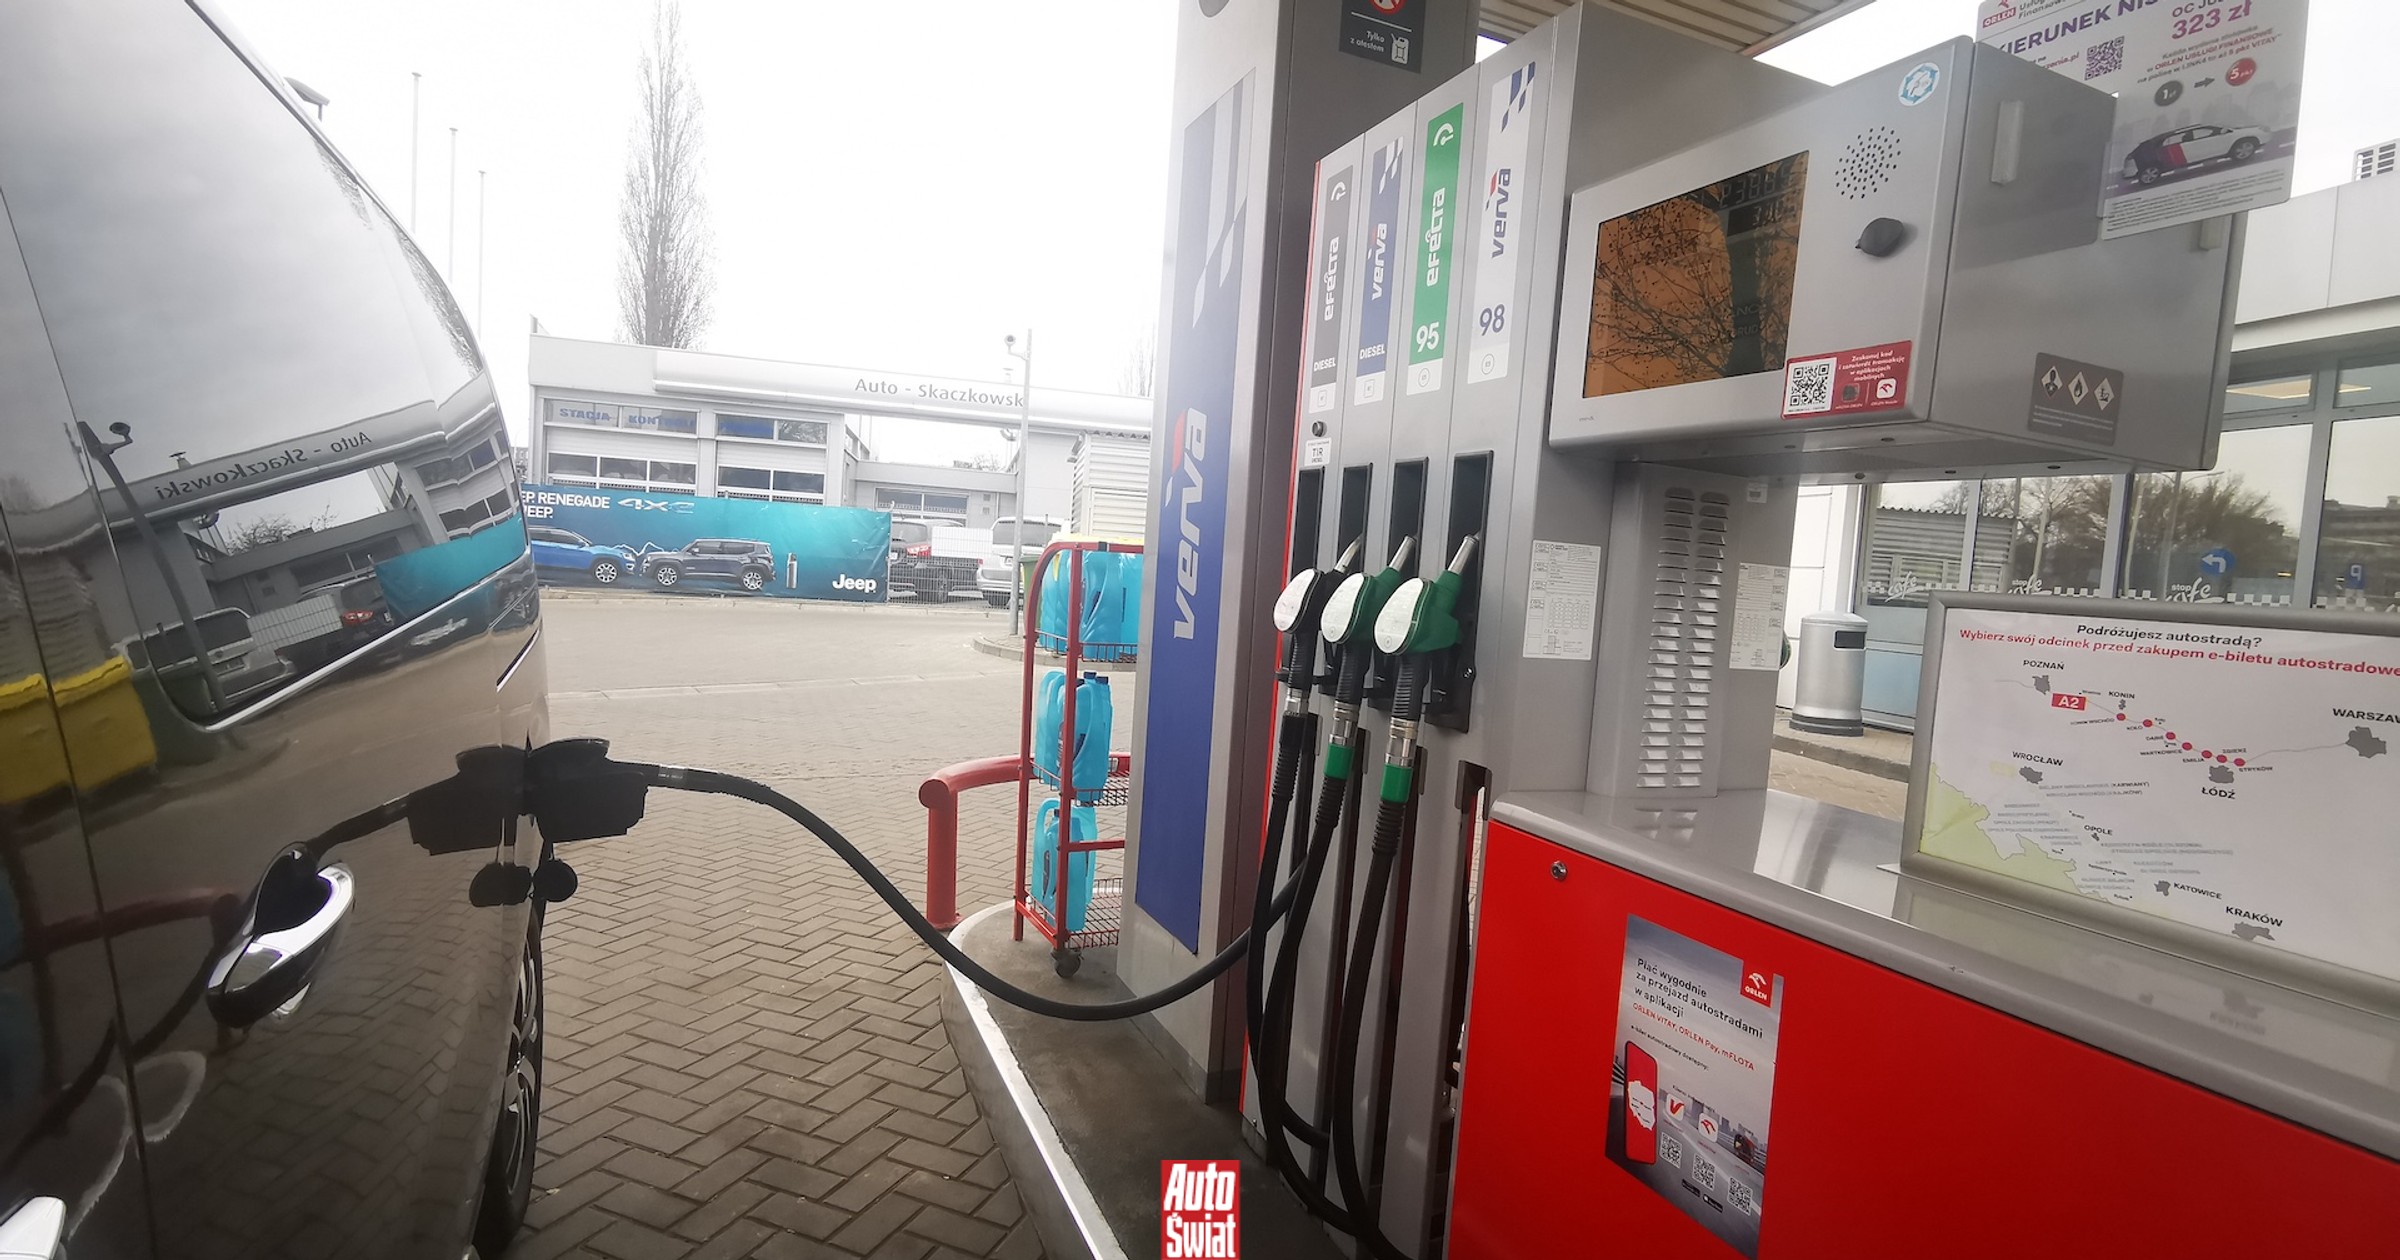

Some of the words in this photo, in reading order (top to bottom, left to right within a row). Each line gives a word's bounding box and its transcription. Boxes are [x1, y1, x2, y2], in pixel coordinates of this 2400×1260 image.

[1984, 8, 2016, 27] ORLEN
[2172, 3, 2195, 17] OC
[2172, 8, 2222, 39] 323
[1366, 30, 1385, 43] Tylko
[2230, 68, 2239, 80] 5
[1492, 168, 1511, 259] verva
[1480, 304, 1505, 336] 98
[1416, 322, 1440, 353] 95
[1359, 344, 1386, 360] DIESEL
[1313, 357, 1337, 372] DIESEL
[855, 378, 898, 395] Auto
[918, 384, 1024, 407] Skaczkowsk
[559, 407, 611, 422] STACJA
[538, 492, 610, 510] RENEGADE
[1172, 407, 1207, 640] verva
[832, 574, 877, 594] Jeep
[2171, 583, 2191, 593] stop
[2077, 624, 2163, 641] Podróżujesz
[2166, 631, 2263, 649] autostradą?
[1960, 629, 2005, 642] Wybierz
[2007, 632, 2035, 646] swój
[2038, 636, 2090, 649] odcinek
[2093, 641, 2134, 653] przed
[2136, 643, 2204, 659] zakupem
[2208, 650, 2273, 665] e-biletu
[2022, 660, 2065, 671] POZNAŃ
[2058, 696, 2080, 709] A2
[2108, 691, 2135, 699] KONIN
[2012, 751, 2064, 767] WROCŁAW
[2202, 786, 2236, 799] ŁÓDŹ
[2084, 824, 2113, 836] OPOLE
[2173, 882, 2223, 900] KATOWICE
[2226, 906, 2284, 927] KRAKÓW
[1660, 970, 1707, 998] wygodnie
[1744, 985, 1767, 1001] ORLEN
[1635, 987, 1643, 996] w
[1644, 991, 1684, 1018] aplikacji
[1636, 972, 1646, 982] za
[1648, 977, 1688, 1003] przejazd
[1691, 998, 1763, 1039] autostradami
[1633, 1002, 1657, 1019] ORLEN
[1678, 1026, 1704, 1045] ORLEN
[1721, 1049, 1754, 1071] mFLOTA
